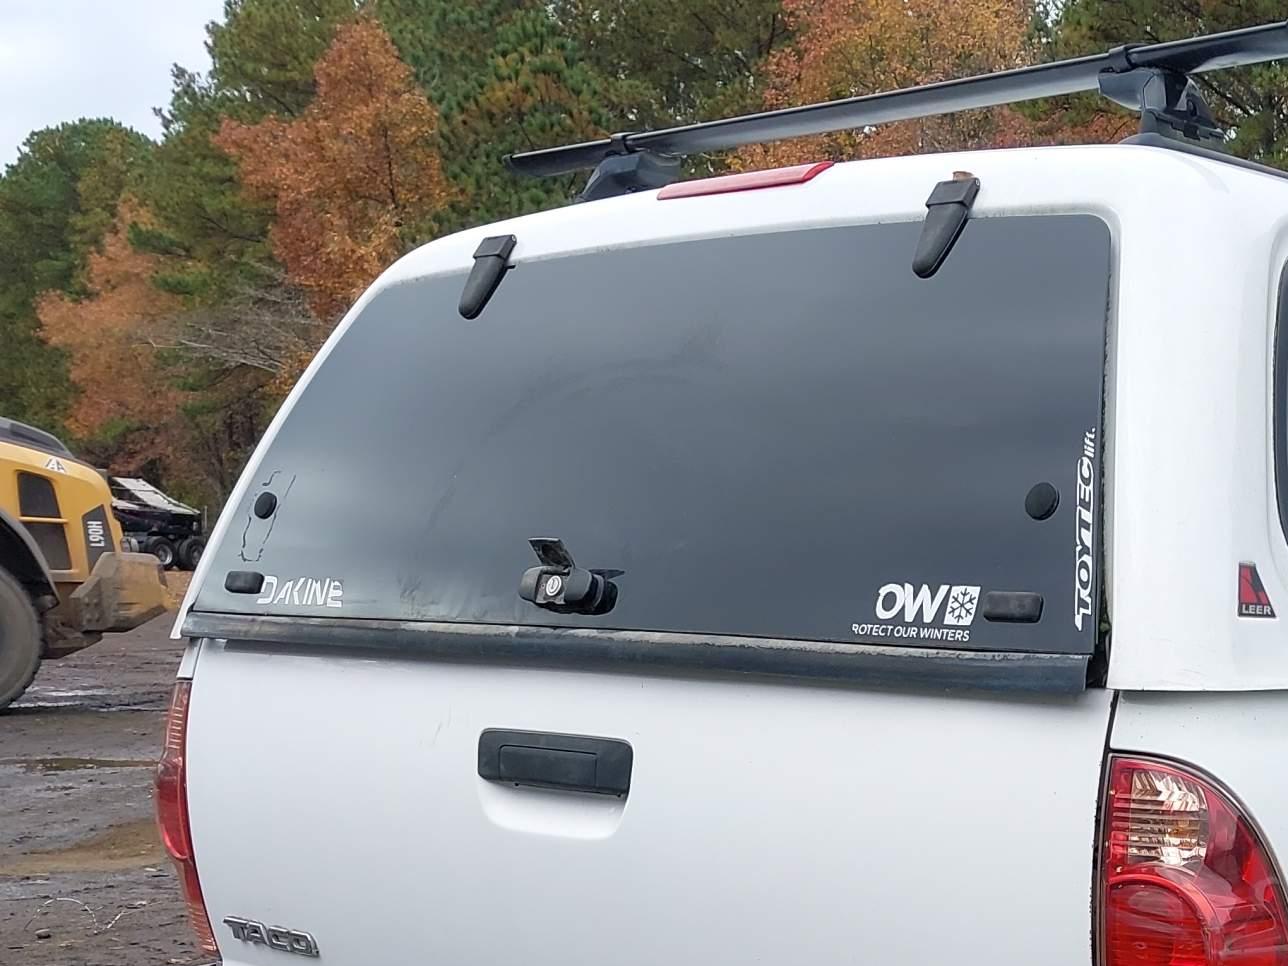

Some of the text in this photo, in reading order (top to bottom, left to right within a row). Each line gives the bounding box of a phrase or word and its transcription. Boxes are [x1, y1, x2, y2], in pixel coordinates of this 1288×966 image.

[87, 521, 105, 547] L90H
[1075, 456, 1094, 631] TOYTEC
[256, 575, 343, 608] DAKINE
[1242, 603, 1272, 616] LEER
[894, 626, 918, 639] OUR
[920, 627, 970, 642] WINTERS
